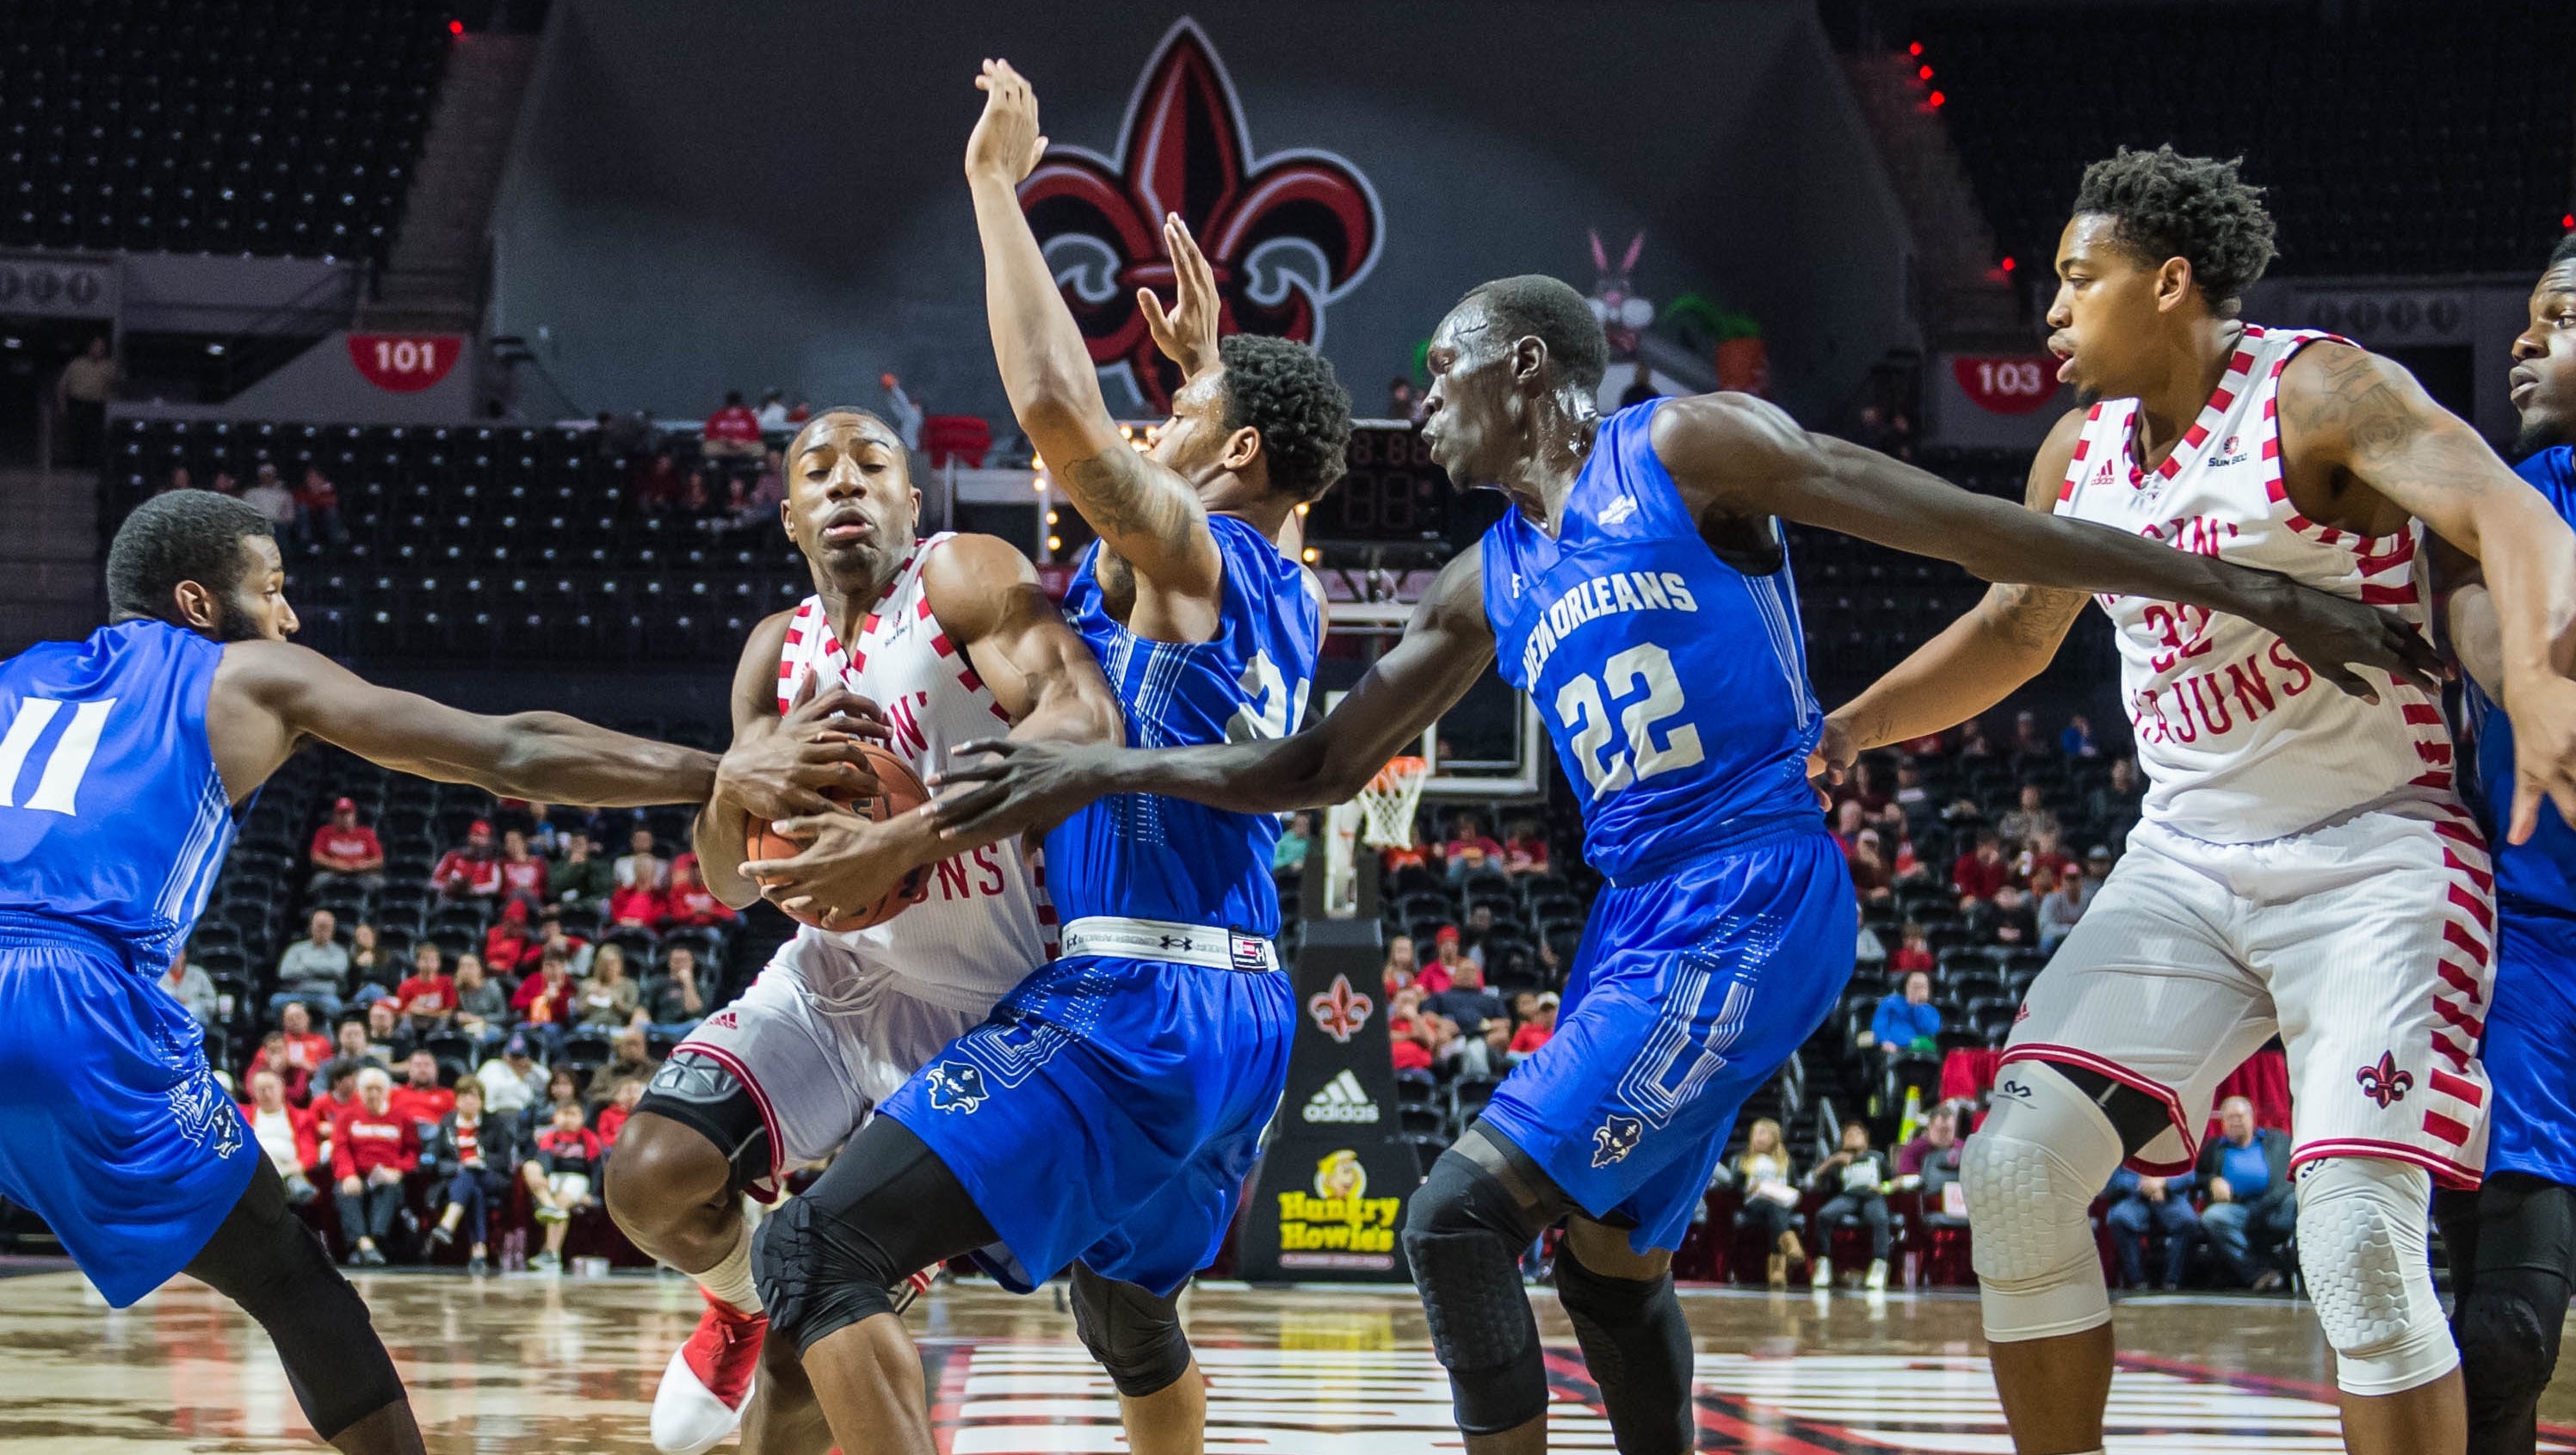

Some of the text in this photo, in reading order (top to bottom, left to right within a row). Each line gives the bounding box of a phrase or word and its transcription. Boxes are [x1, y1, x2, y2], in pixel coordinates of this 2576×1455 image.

[375, 341, 435, 373] 101
[1979, 362, 2042, 395] 103
[1522, 571, 1698, 694] NEW ORLEANS
[2143, 602, 2213, 674] 32
[1555, 642, 1705, 801] 22
[0, 696, 118, 817] 11
[1302, 1102, 1380, 1123] adidas
[1277, 1191, 1400, 1229] Hungry
[1280, 1220, 1394, 1252] Howie's
